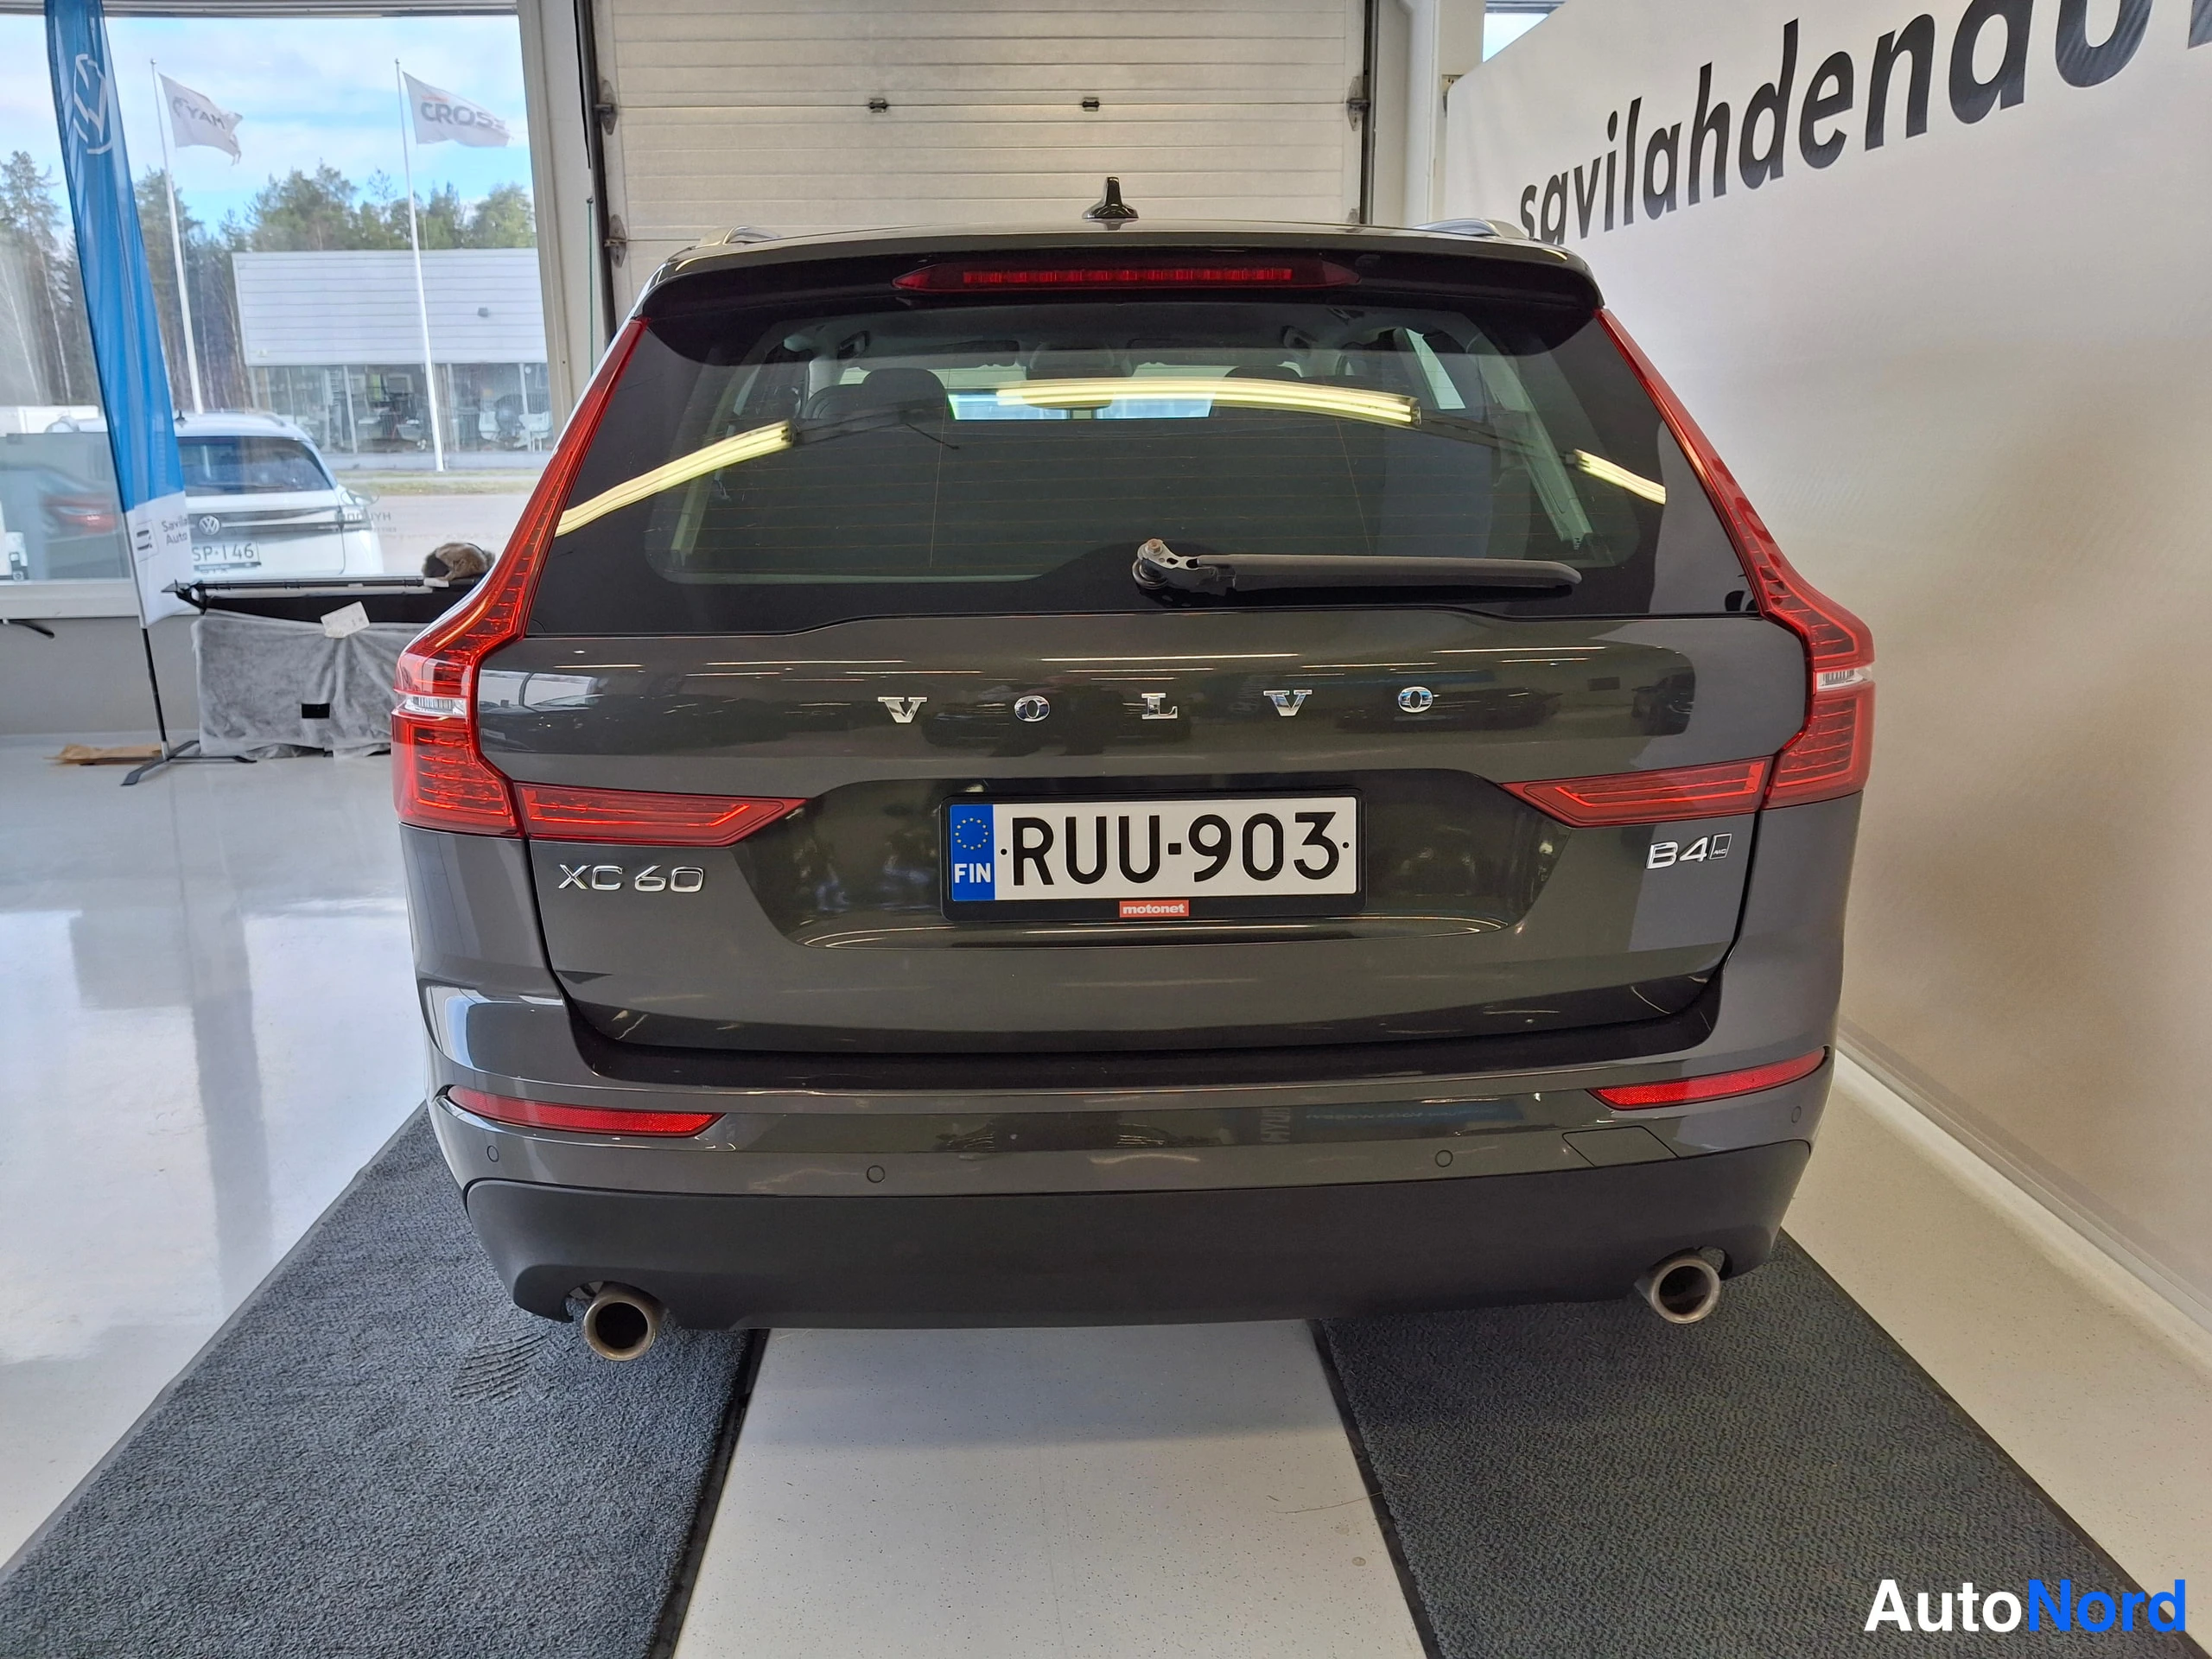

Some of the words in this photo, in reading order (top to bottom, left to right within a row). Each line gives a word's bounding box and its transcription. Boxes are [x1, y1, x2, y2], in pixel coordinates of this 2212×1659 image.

[1521, 0, 2212, 245] savilahdenau
[166, 532, 188, 546] Auto
[192, 543, 254, 563] SP-146
[878, 686, 1433, 724] VOLVO
[954, 862, 991, 883] FIN
[1012, 811, 1340, 887] RUU-903
[1646, 836, 1708, 869] B4
[1122, 903, 1185, 915] motonet
